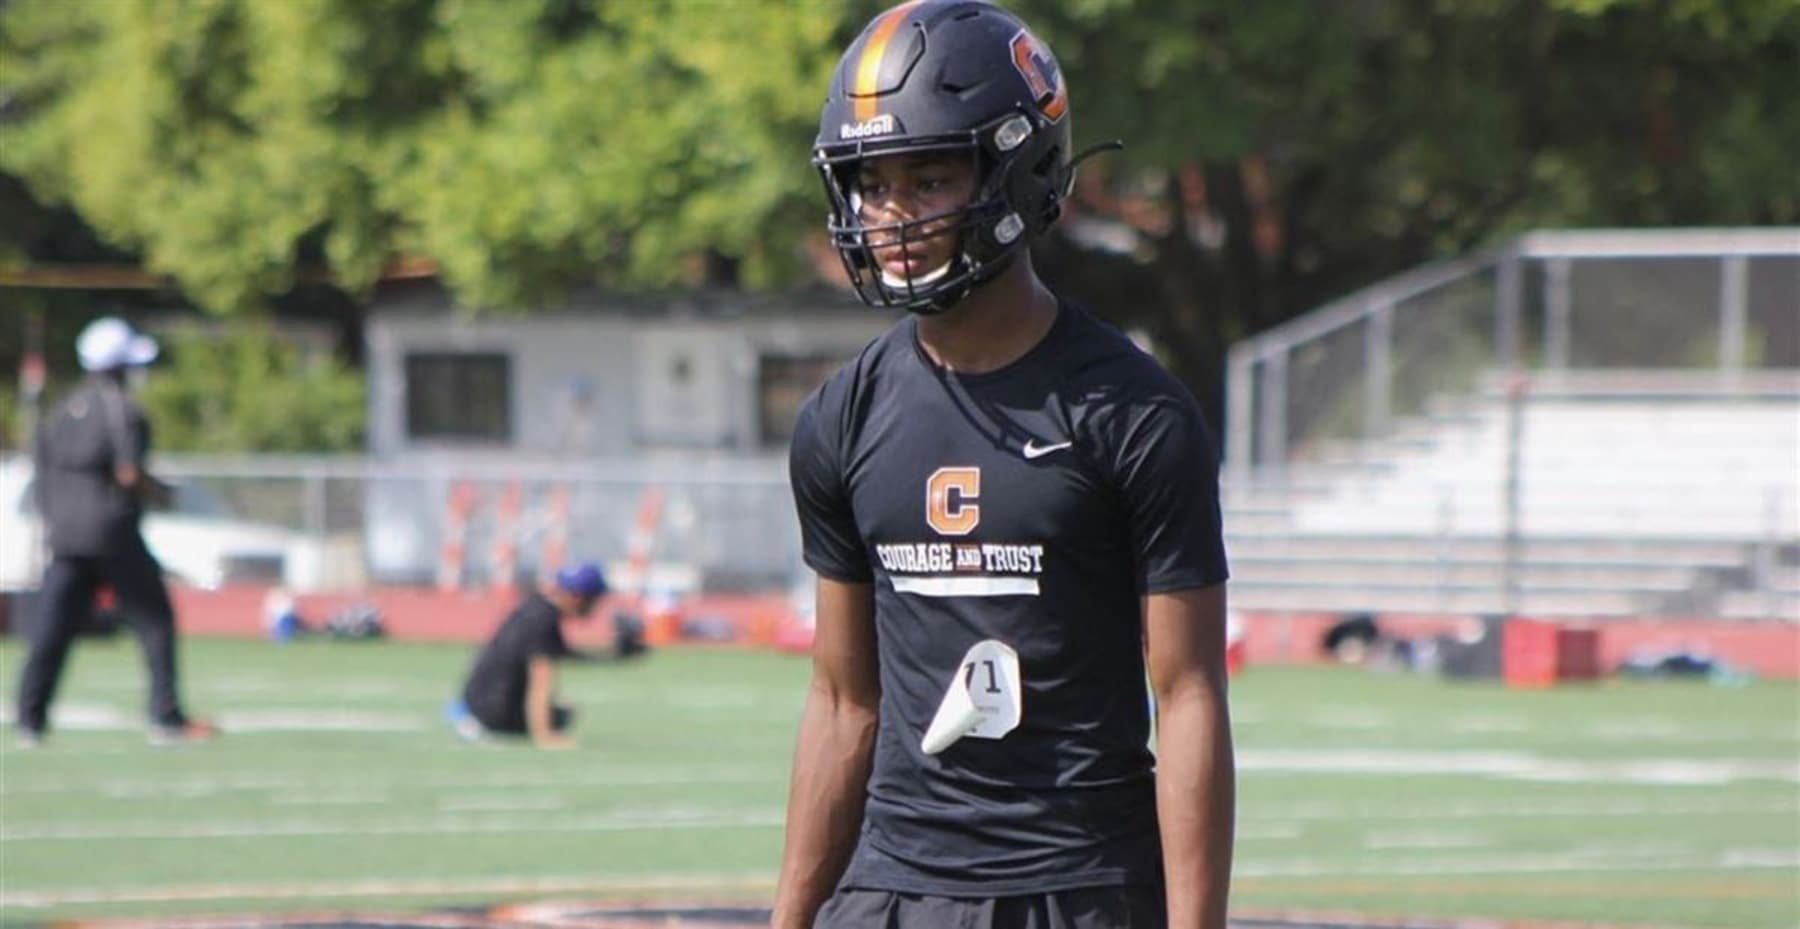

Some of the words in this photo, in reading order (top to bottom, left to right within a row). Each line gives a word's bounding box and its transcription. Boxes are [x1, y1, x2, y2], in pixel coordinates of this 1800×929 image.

[841, 113, 893, 139] Riddell
[926, 466, 981, 535] C
[876, 543, 953, 572] COURAGE
[956, 546, 982, 567] AND
[982, 544, 1044, 573] TRUST
